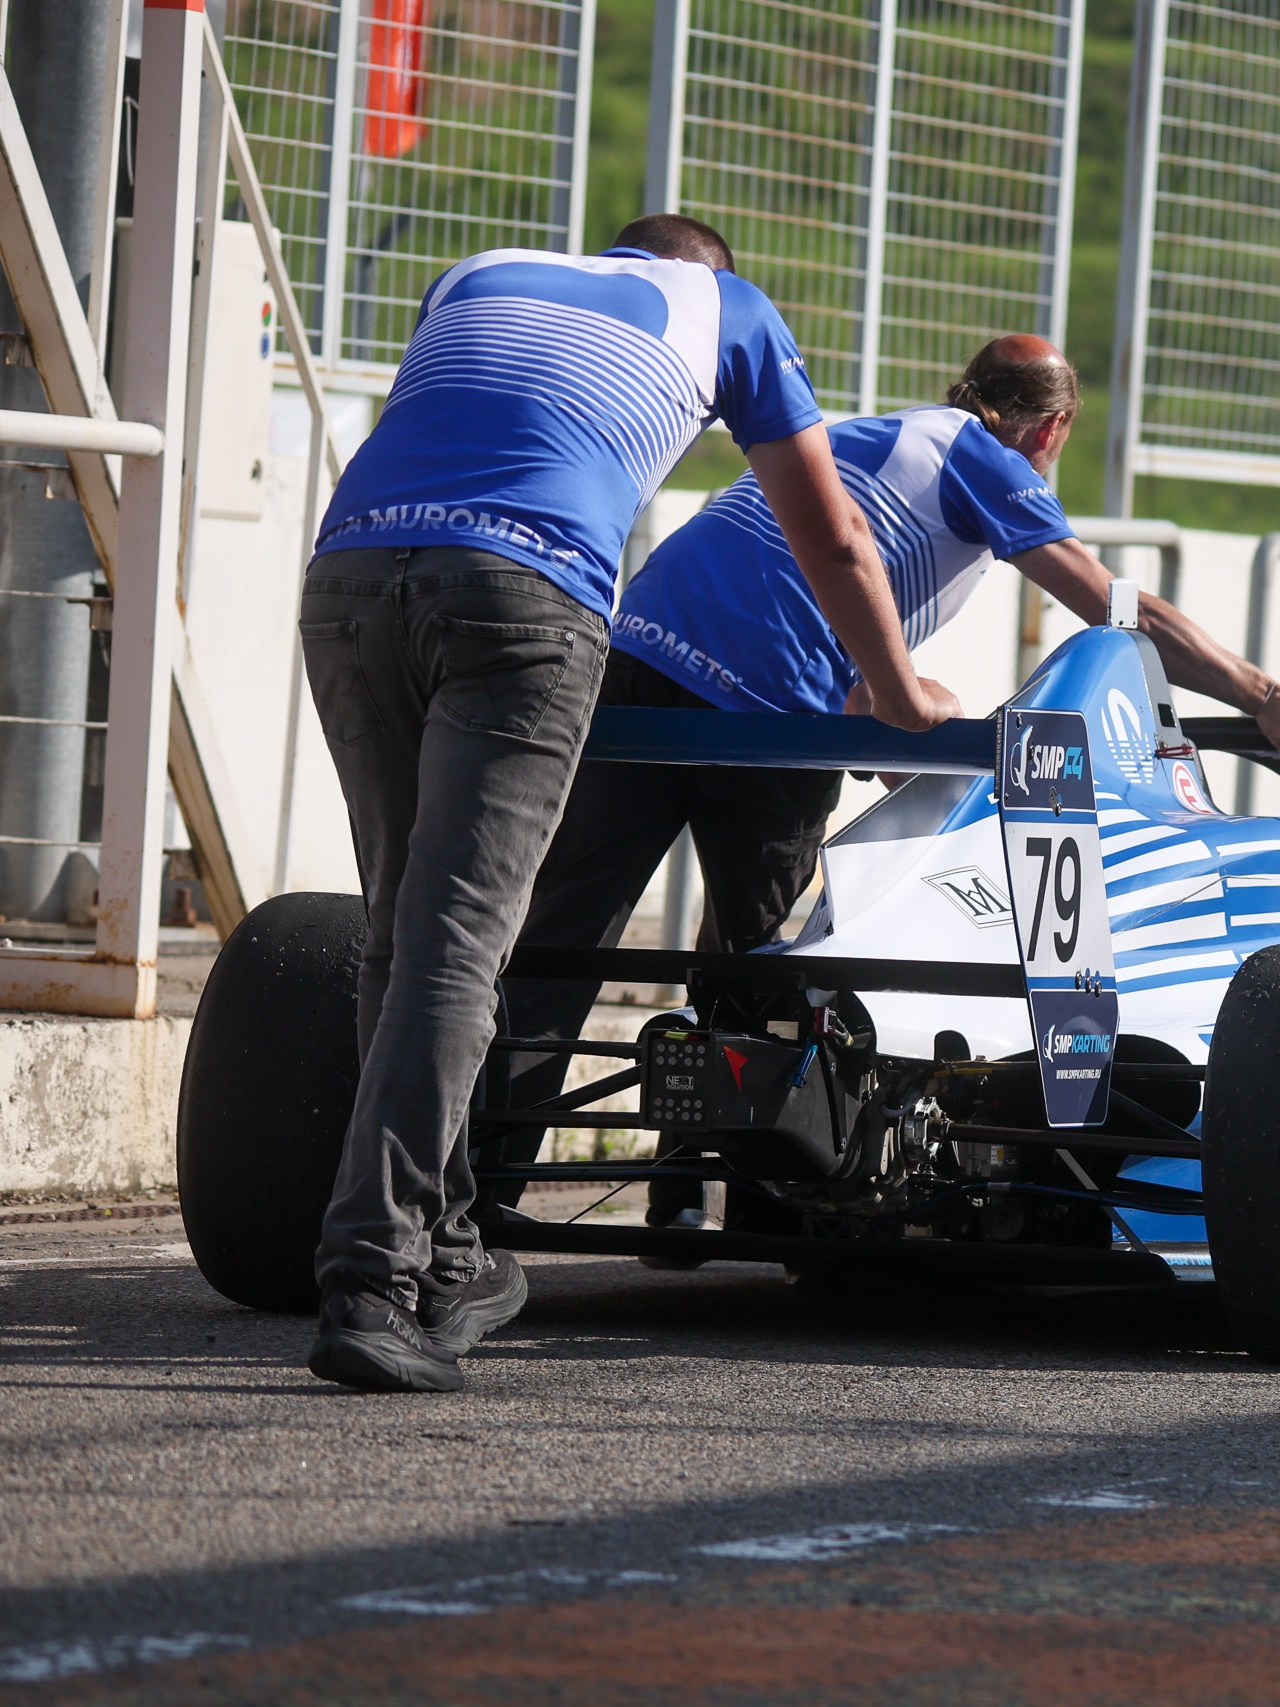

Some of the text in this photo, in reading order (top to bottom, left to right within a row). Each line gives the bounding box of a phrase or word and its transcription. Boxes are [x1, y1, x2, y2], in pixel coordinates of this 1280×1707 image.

[369, 504, 574, 571] MUROMETS
[612, 612, 738, 693] UROMETS
[1026, 836, 1082, 964] 79
[1056, 1069, 1102, 1080] WWW.SMPKARTING.RU
[386, 1309, 422, 1351] HOKA
